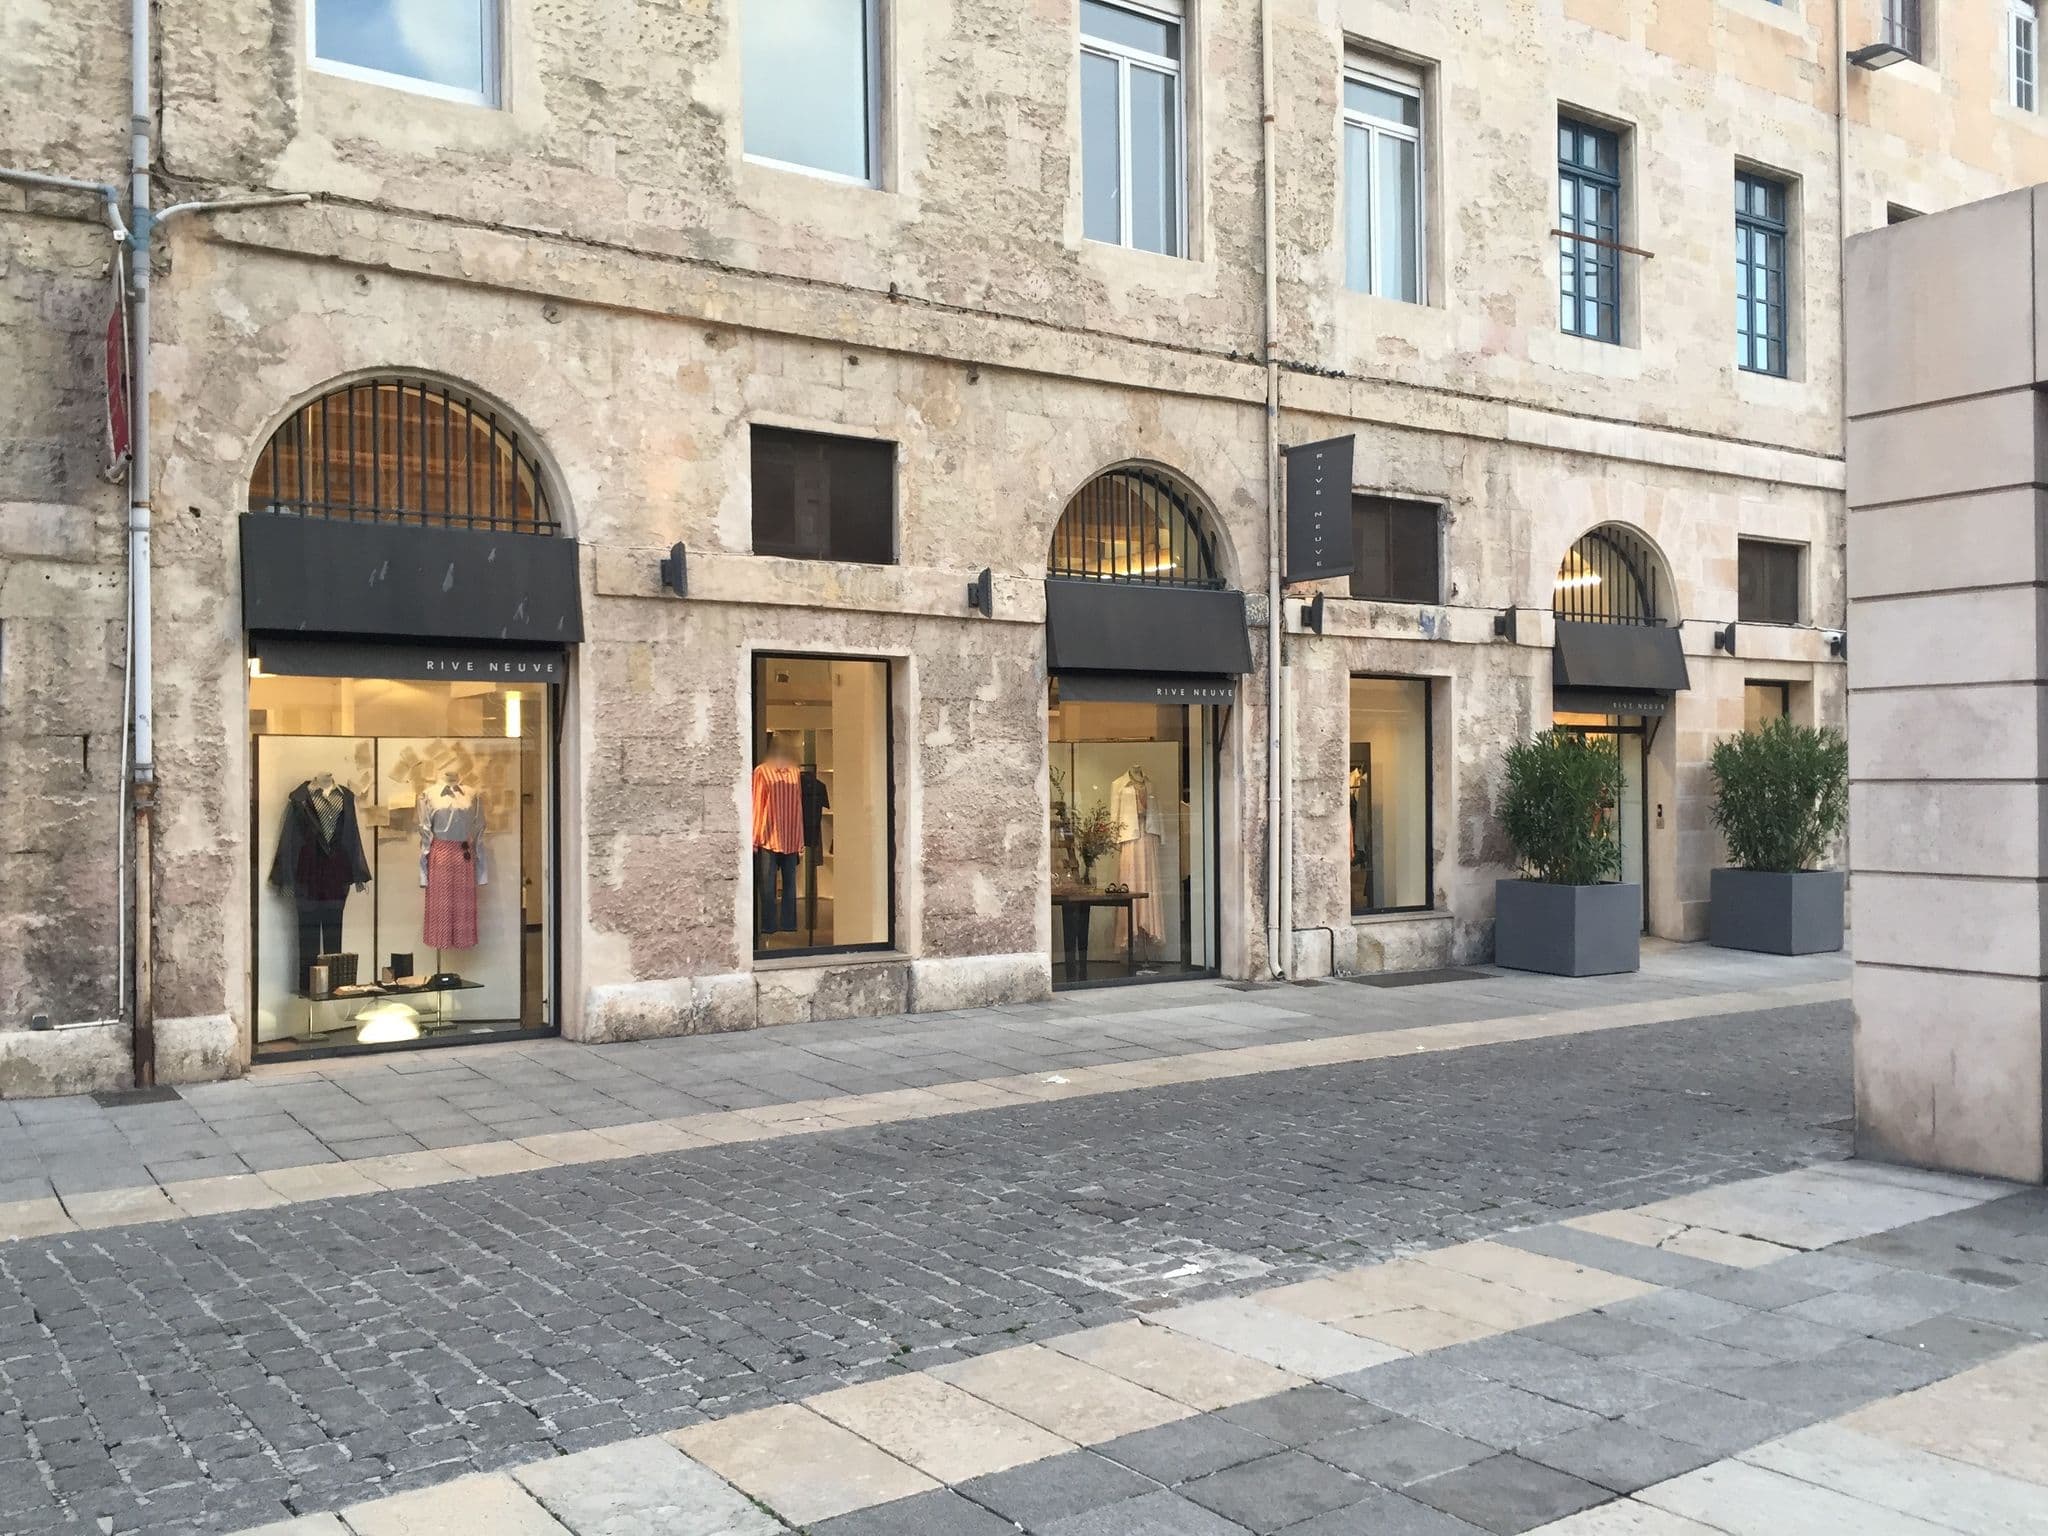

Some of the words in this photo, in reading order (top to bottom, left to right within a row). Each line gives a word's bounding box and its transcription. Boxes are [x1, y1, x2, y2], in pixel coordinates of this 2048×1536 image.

[1314, 452, 1324, 496] RIVE
[1314, 511, 1323, 567] NEUVE
[426, 660, 474, 671] RIVE
[489, 662, 553, 673] NEUVE
[1156, 688, 1185, 696] RIVE
[1193, 689, 1233, 697] NEUVE
